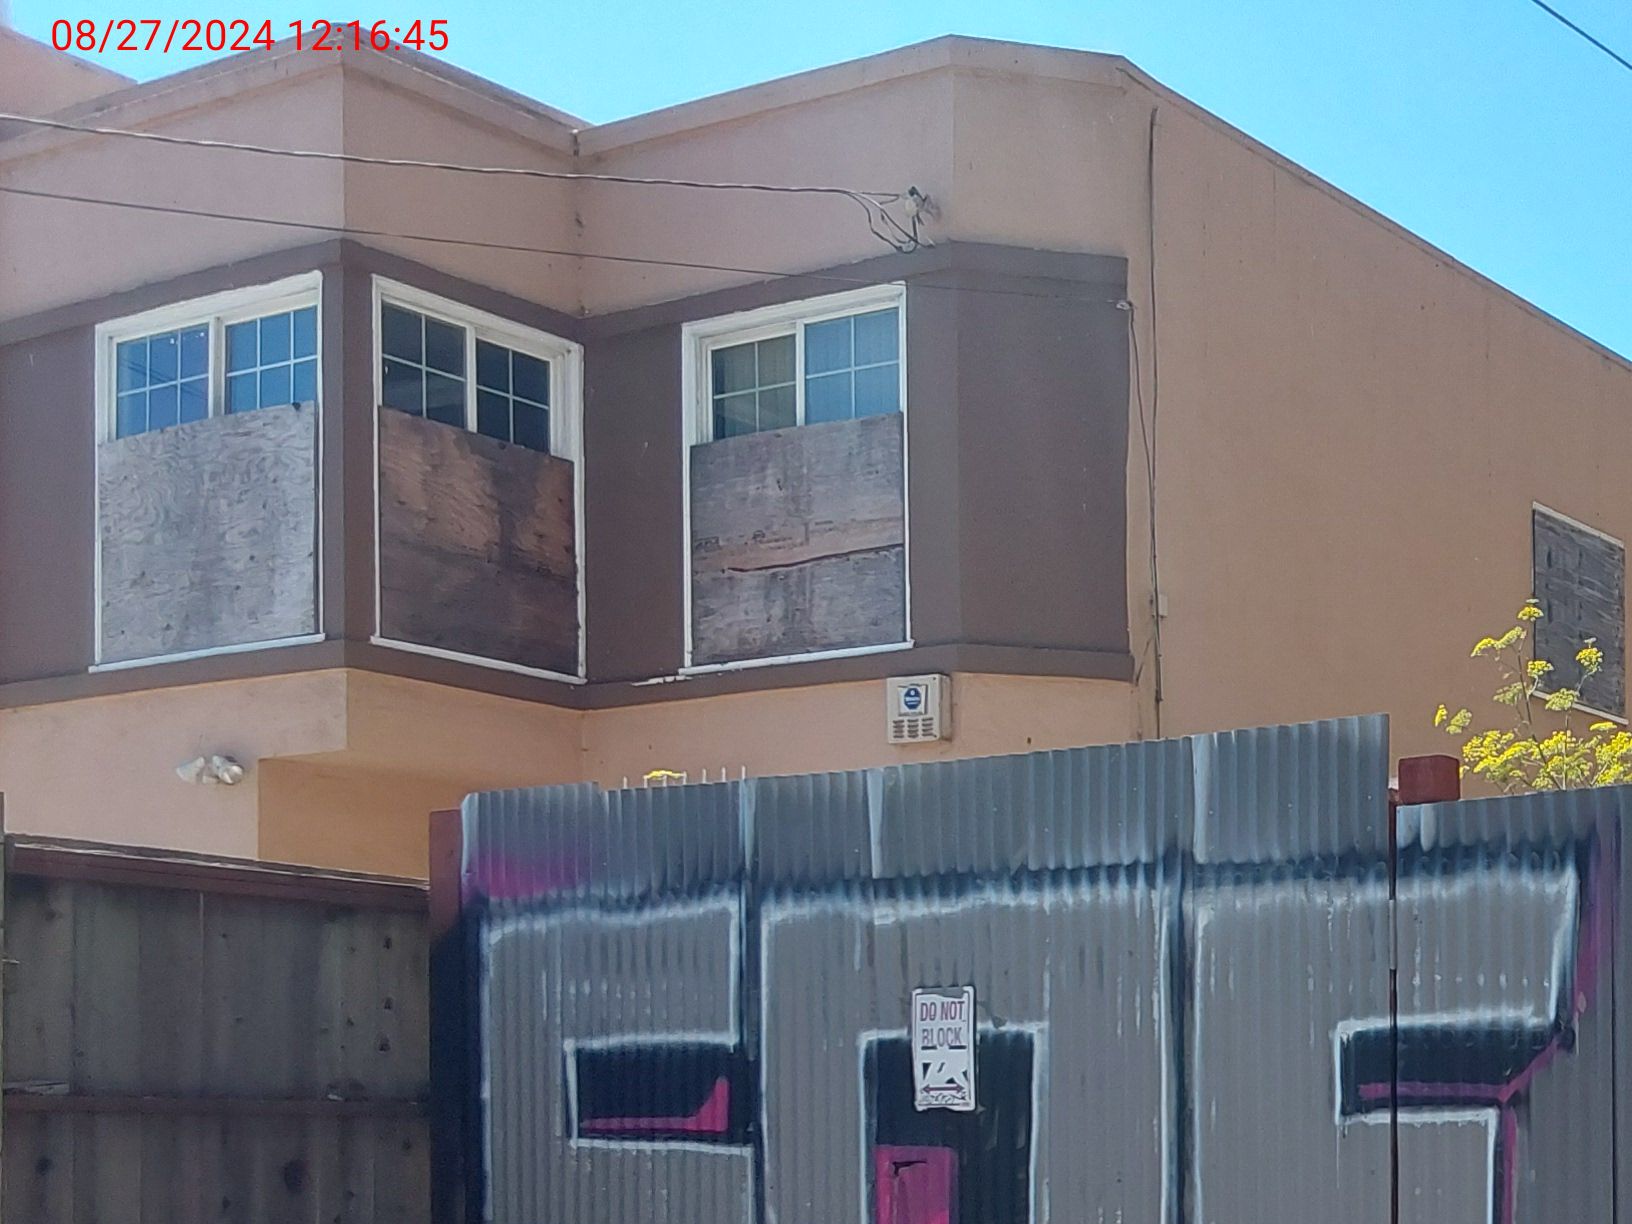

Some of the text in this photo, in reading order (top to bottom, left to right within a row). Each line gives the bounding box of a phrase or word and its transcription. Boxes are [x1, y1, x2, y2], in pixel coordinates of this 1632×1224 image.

[920, 1001, 965, 1021] DO NOT
[921, 1027, 962, 1047] BLOCK
